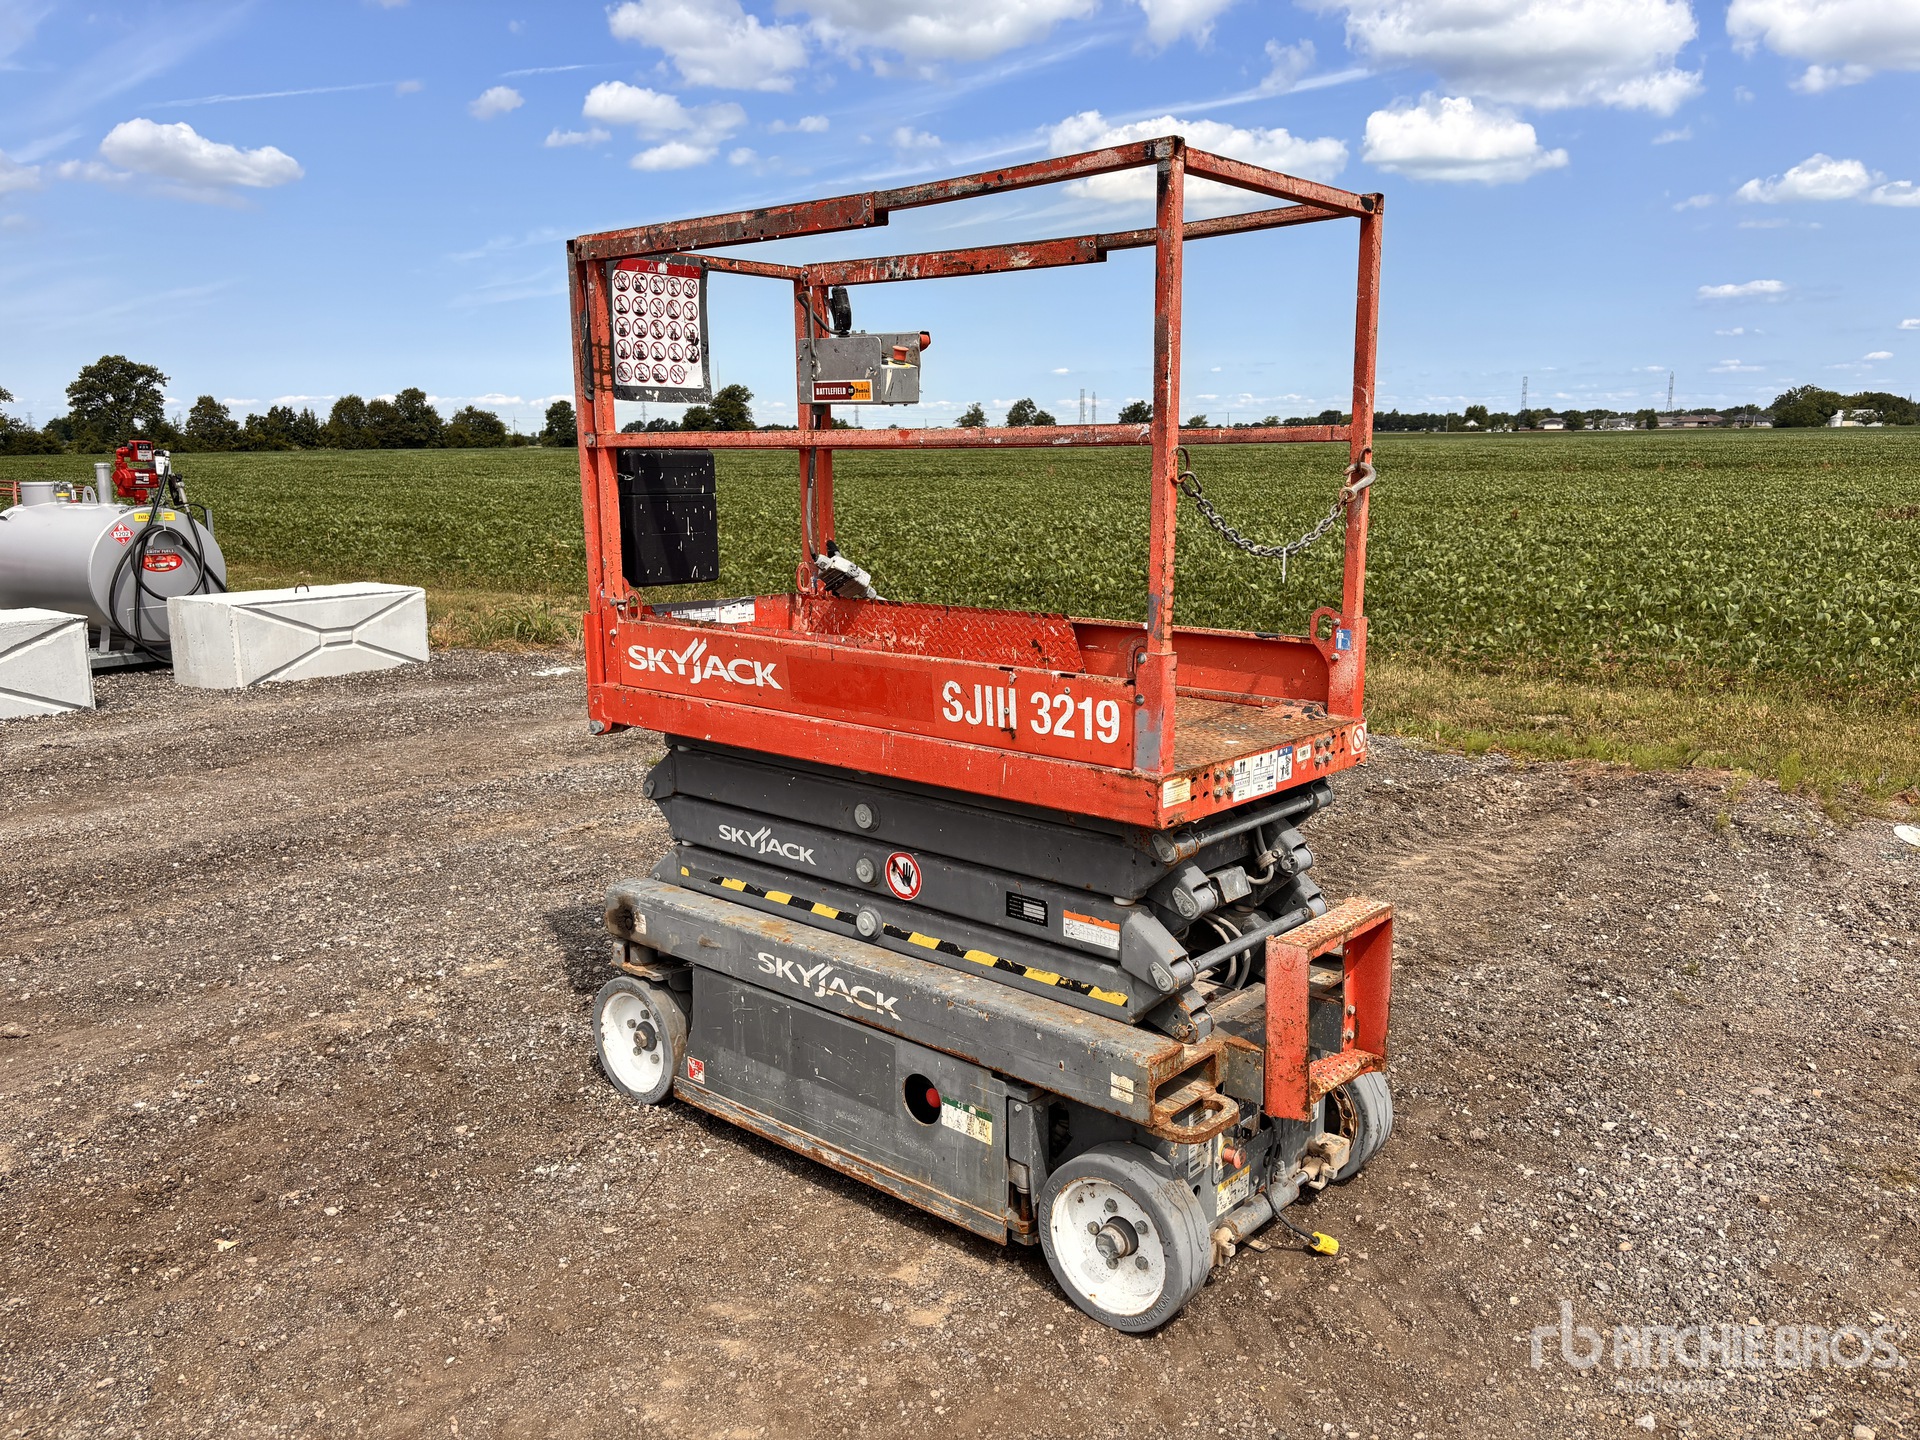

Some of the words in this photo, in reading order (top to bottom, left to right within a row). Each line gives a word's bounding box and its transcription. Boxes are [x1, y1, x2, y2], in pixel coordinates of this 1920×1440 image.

[816, 387, 846, 395] BATTLEFIELD
[627, 637, 784, 690] SKYJACK
[942, 680, 1017, 730] SJIII
[1030, 691, 1120, 743] 3219
[718, 824, 817, 866] SKYJACK
[757, 951, 903, 1022] SKYJACK
[1120, 1309, 1158, 1327] MARKING
[1155, 1293, 1170, 1313] NON
